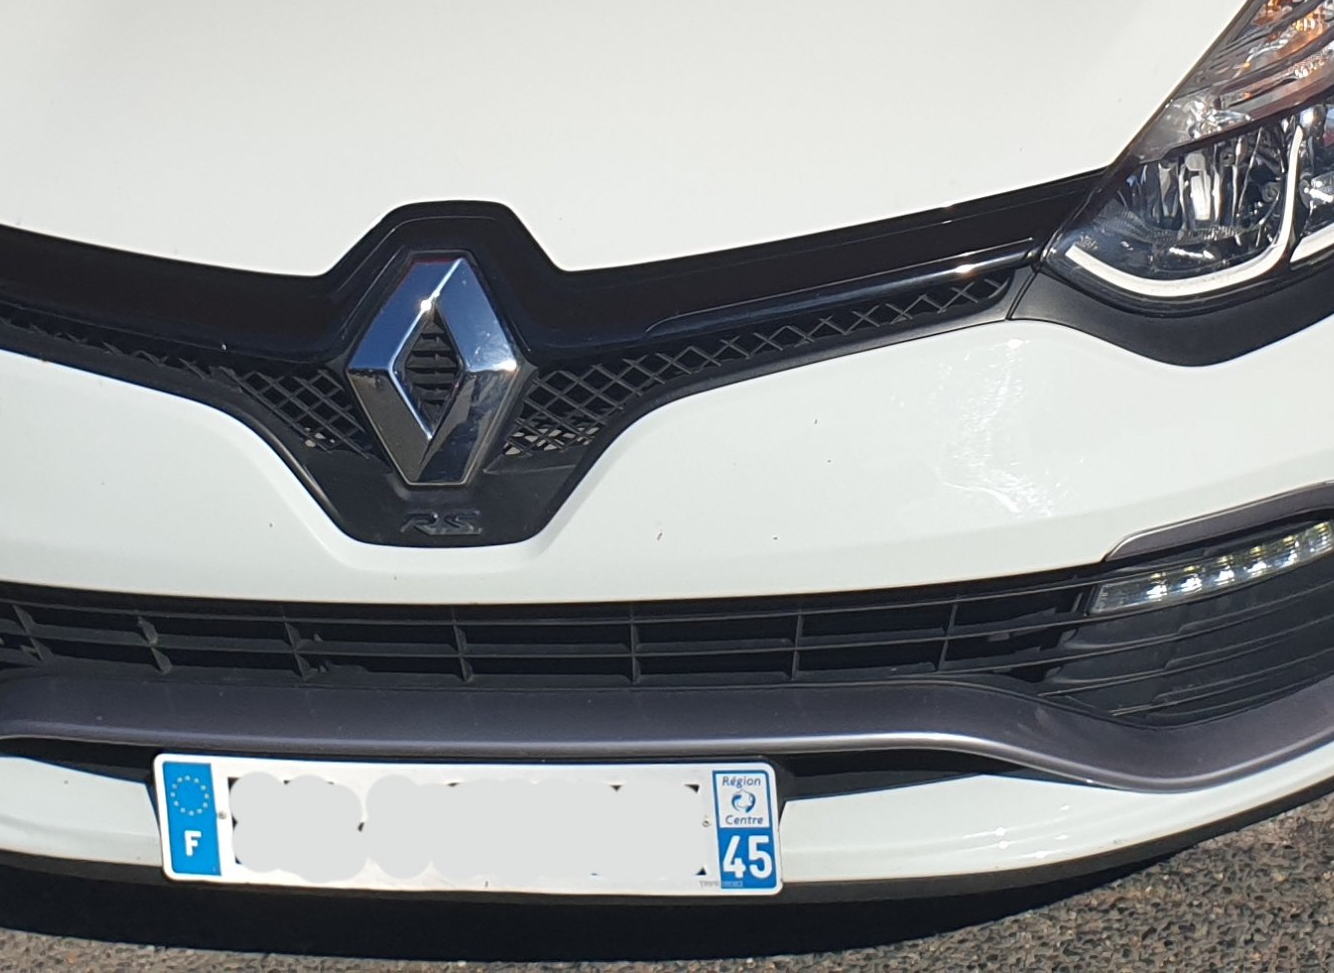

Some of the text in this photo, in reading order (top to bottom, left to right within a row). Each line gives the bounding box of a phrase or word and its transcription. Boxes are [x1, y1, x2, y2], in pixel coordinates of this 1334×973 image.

[722, 775, 761, 789] Région
[725, 814, 764, 825] Centre
[184, 830, 202, 857] F
[723, 835, 773, 878] 45
